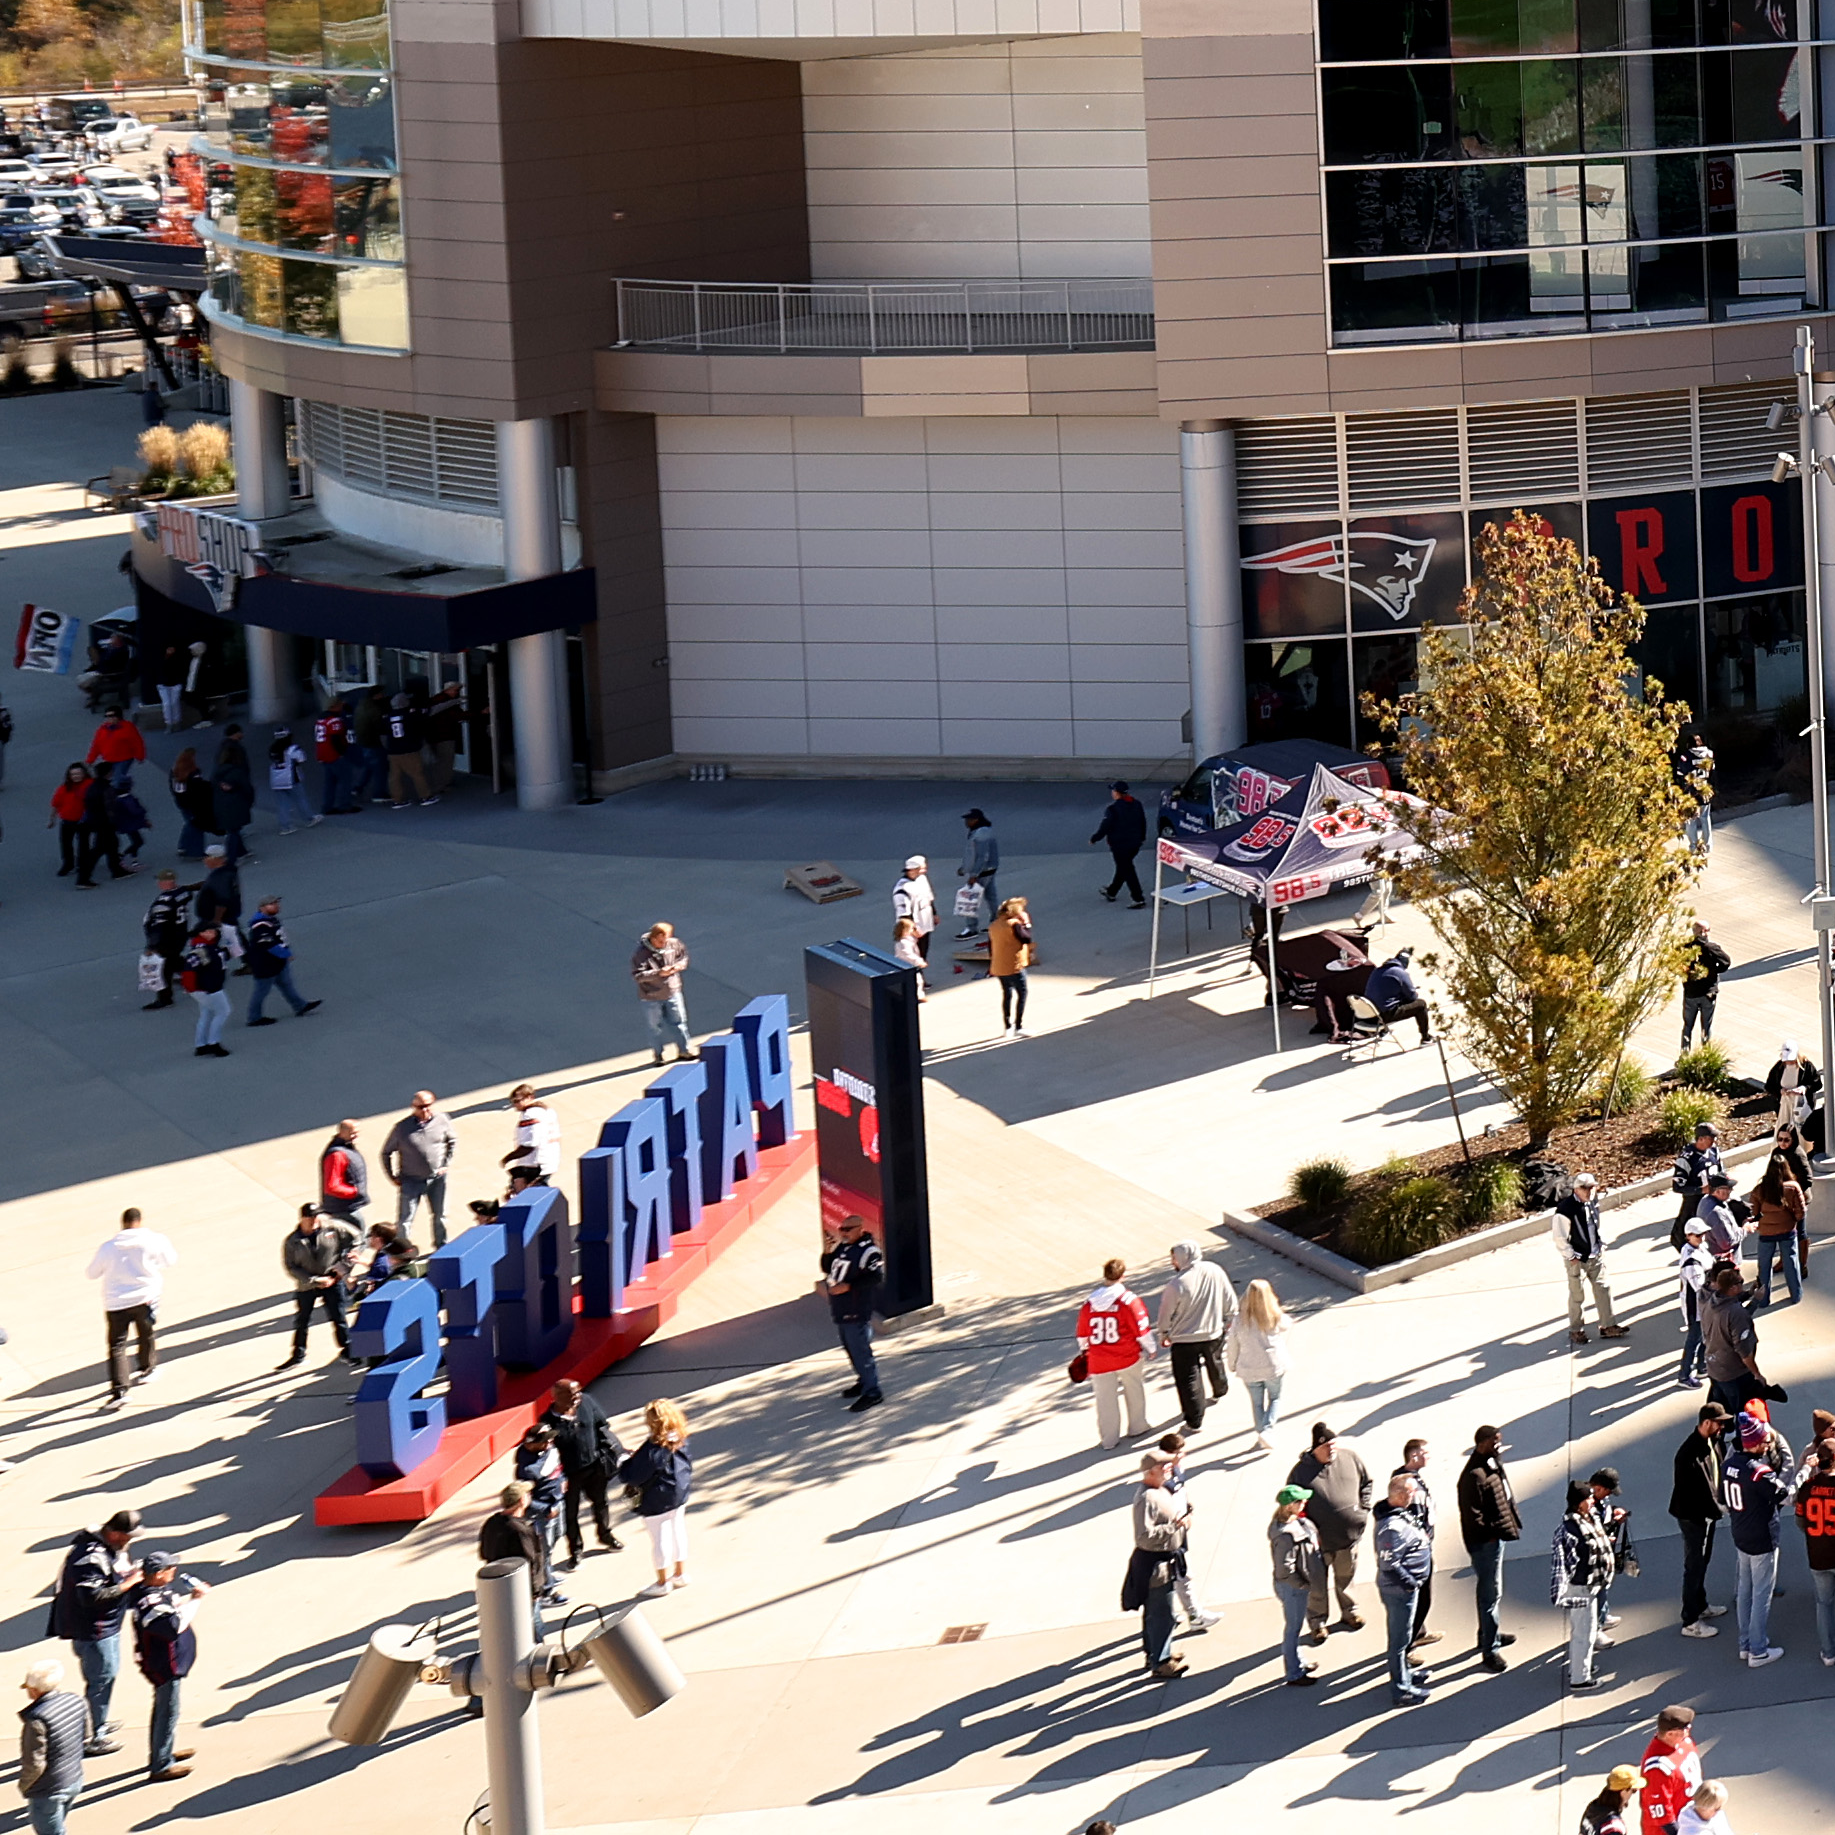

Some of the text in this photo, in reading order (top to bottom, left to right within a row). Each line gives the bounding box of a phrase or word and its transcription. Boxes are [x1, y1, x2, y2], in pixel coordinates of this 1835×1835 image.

[1236, 766, 1292, 817] 985
[1239, 816, 1297, 849] 98.5
[1274, 874, 1322, 904] 98.5
[1090, 1317, 1120, 1345] 38
[1723, 1479, 1745, 1512] 10
[1649, 1805, 1664, 1818] 50
